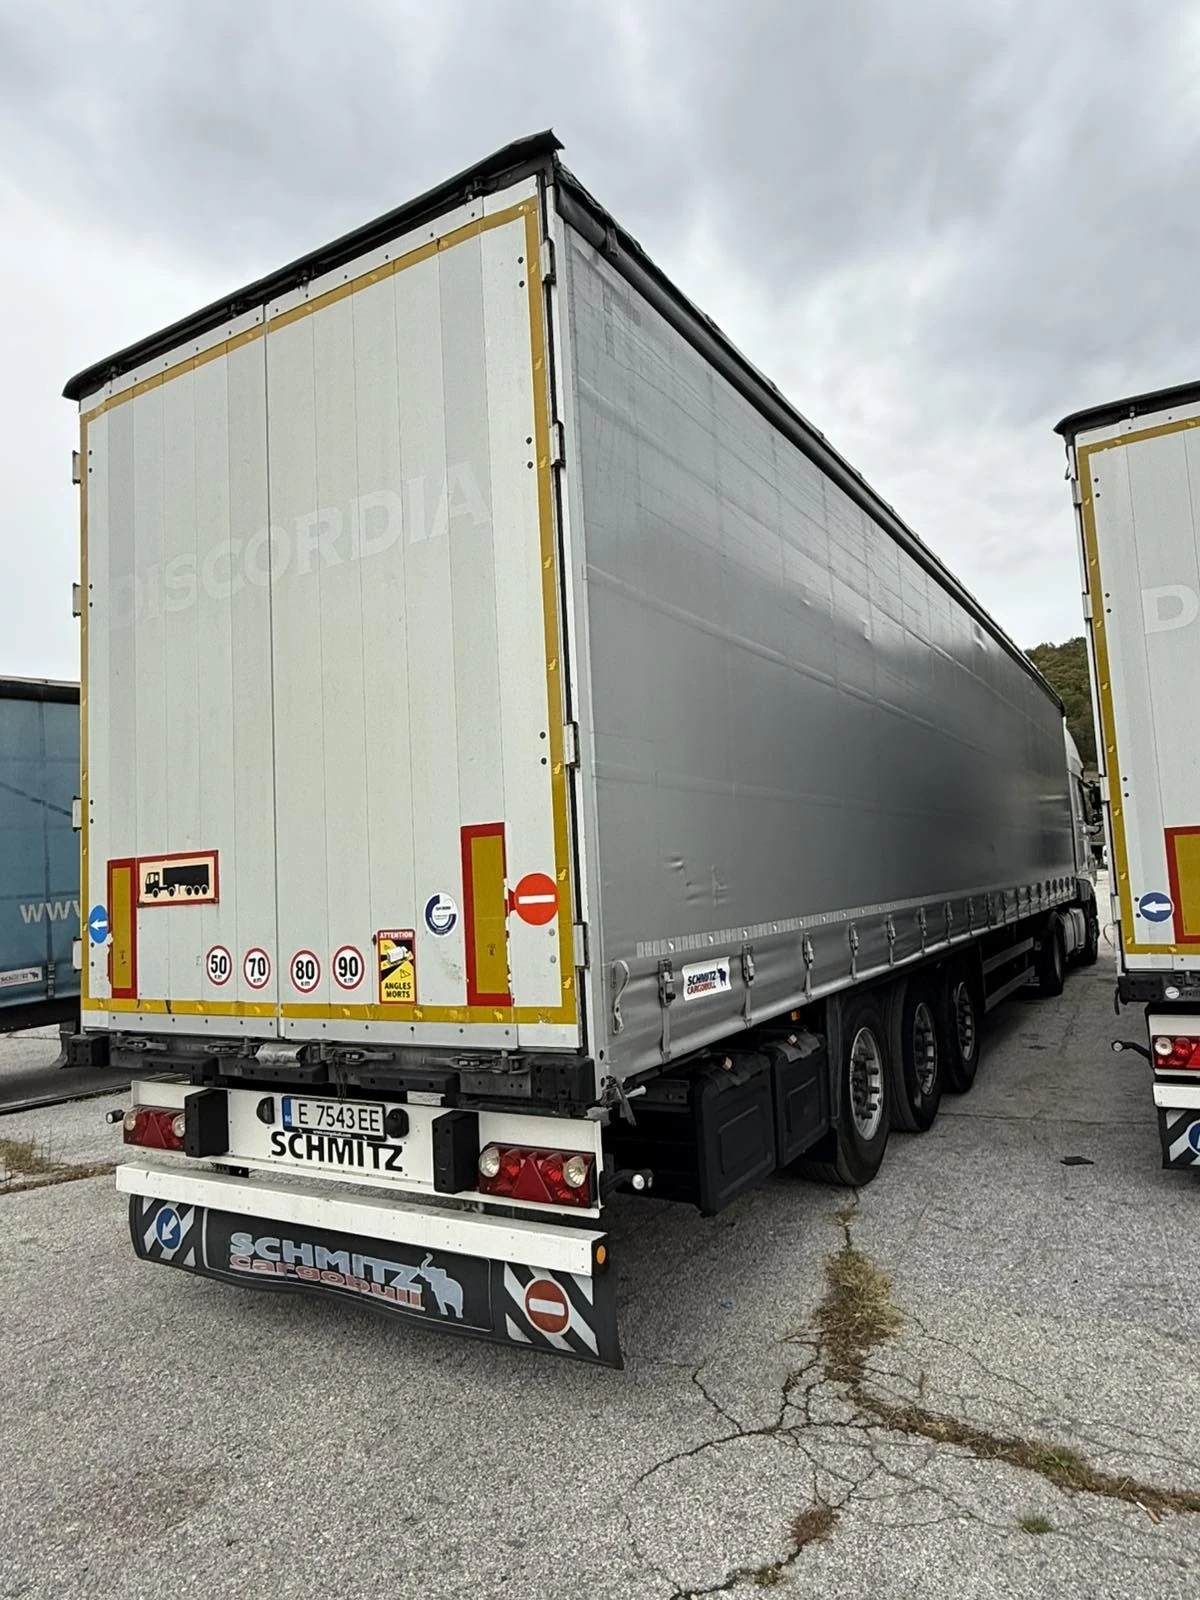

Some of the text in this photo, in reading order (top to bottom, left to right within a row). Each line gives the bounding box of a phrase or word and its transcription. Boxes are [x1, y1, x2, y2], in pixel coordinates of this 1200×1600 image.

[210, 954, 227, 974] 50
[248, 957, 266, 977] 70
[295, 960, 315, 980] 80
[338, 956, 359, 978] 90
[384, 982, 412, 990] ANGLES
[687, 970, 716, 987] SCHMITZ
[687, 982, 716, 994] CARGOBULL
[386, 990, 410, 998] MORTS
[298, 1103, 380, 1132] E 7543 EE
[270, 1131, 403, 1172] SCHMITZ
[230, 1232, 422, 1293] SCHMITZ
[229, 1254, 423, 1310] cargobull
